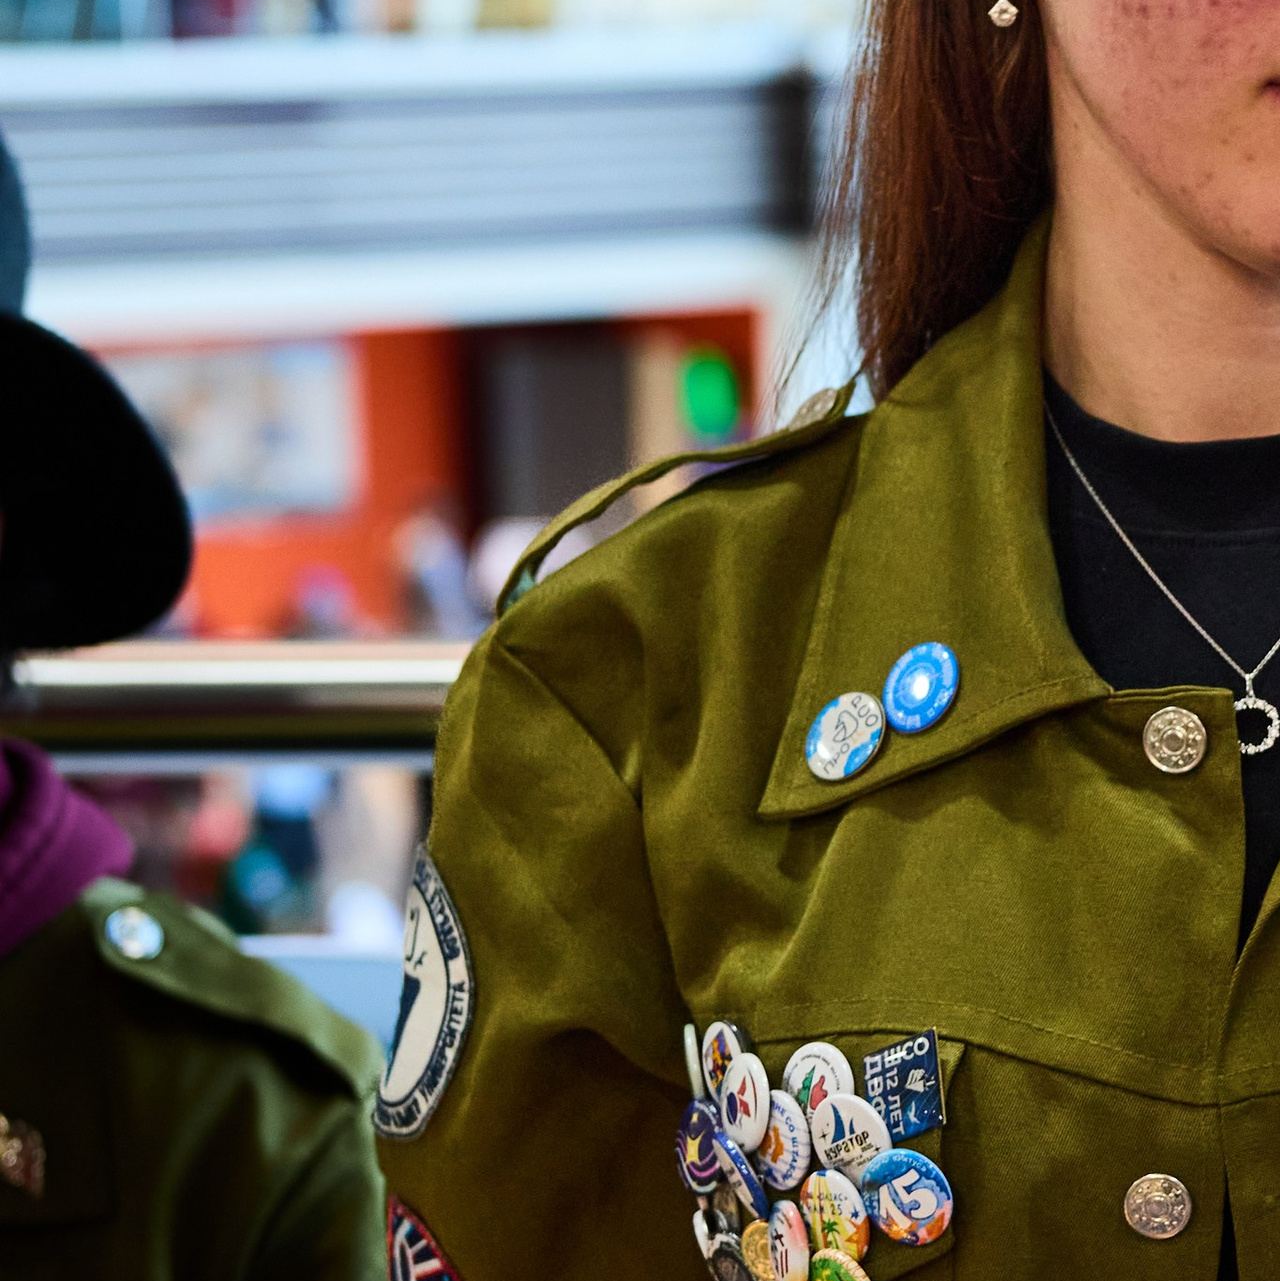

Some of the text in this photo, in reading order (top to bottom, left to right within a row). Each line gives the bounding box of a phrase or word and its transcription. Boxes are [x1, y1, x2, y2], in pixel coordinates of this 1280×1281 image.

[864, 1055, 888, 1123] ДВФ
[885, 1070, 905, 1136] 12 ЛЕТ
[878, 1167, 938, 1230] 15
